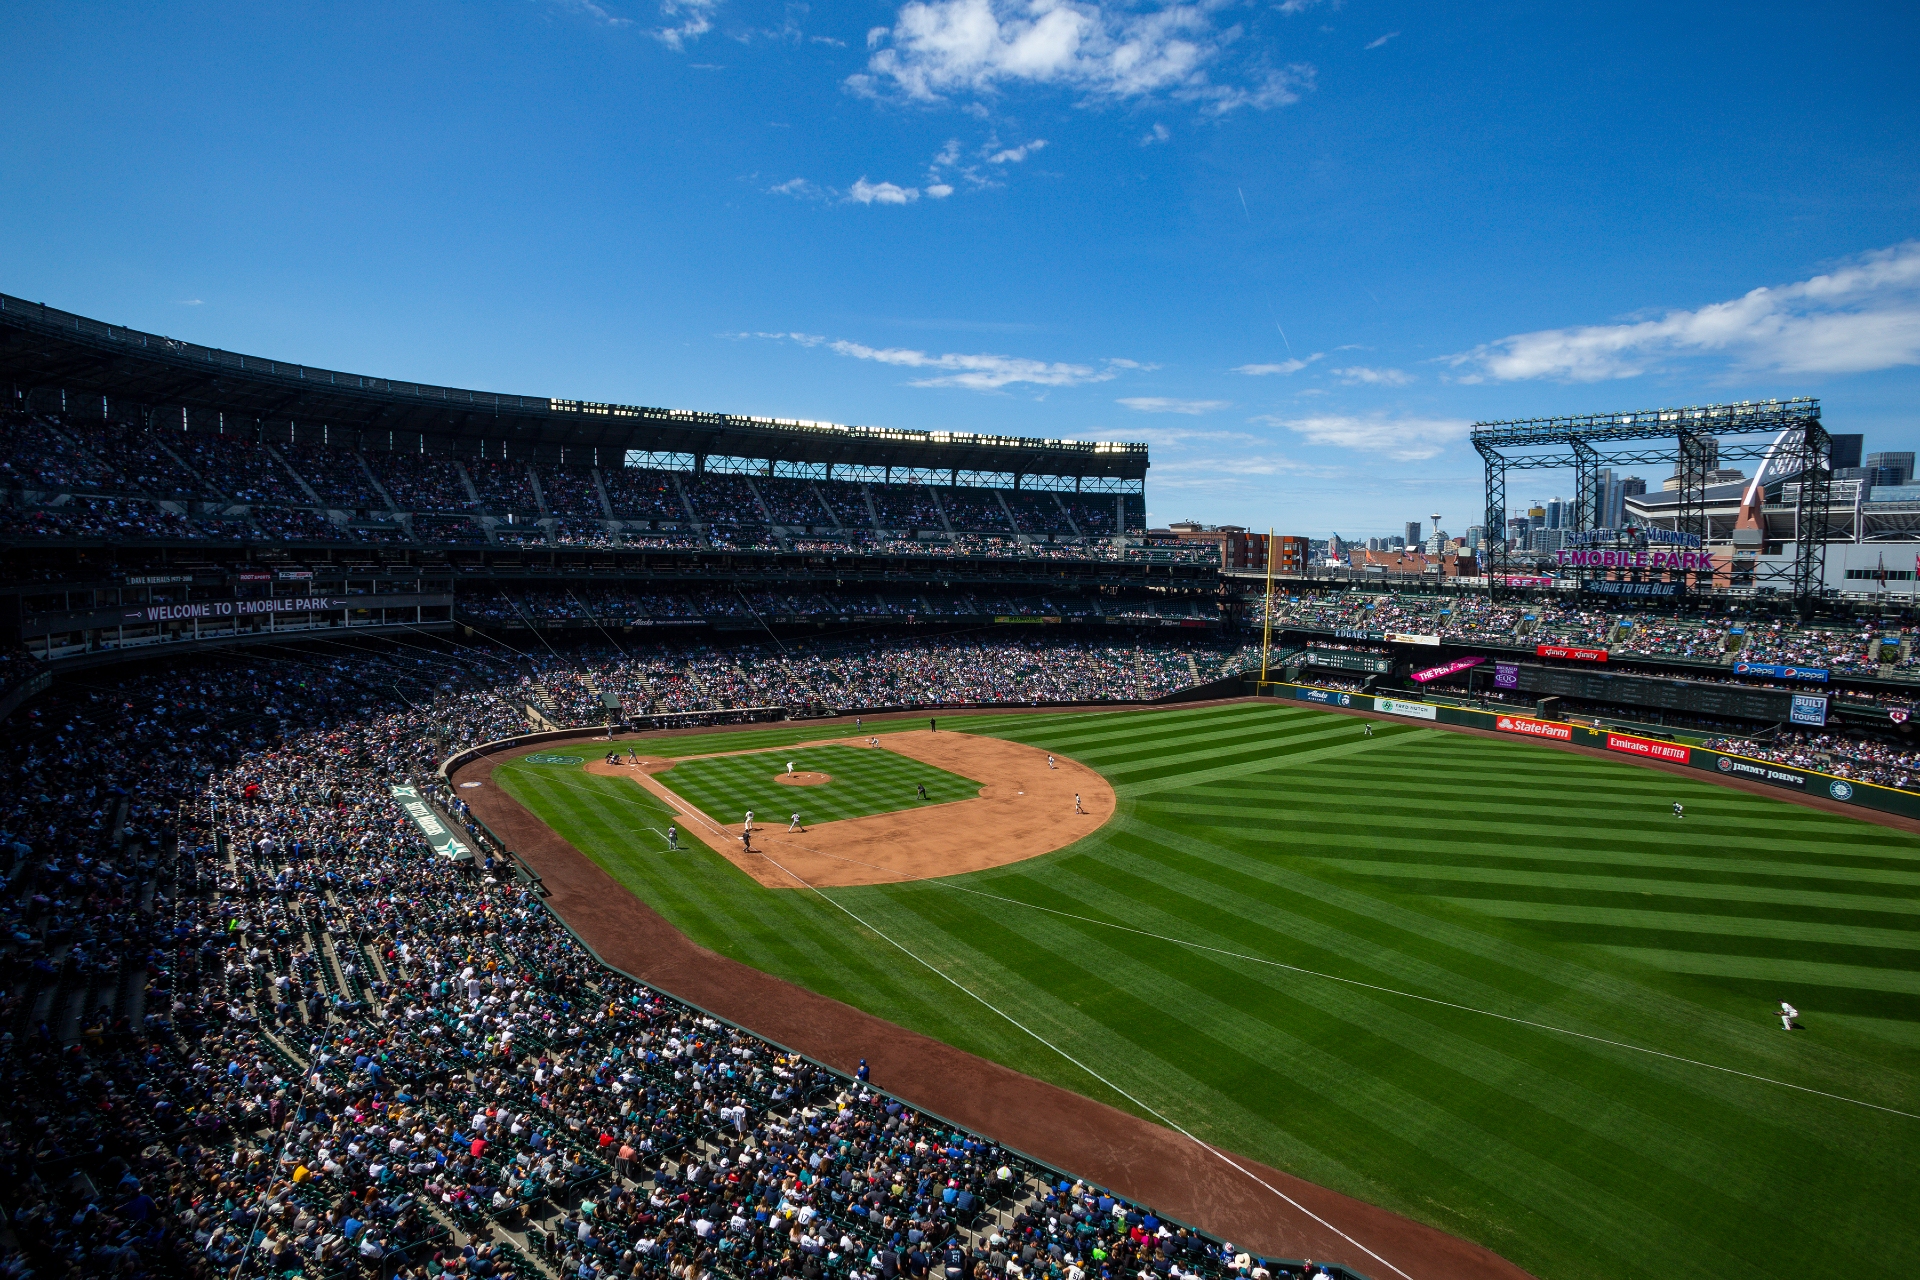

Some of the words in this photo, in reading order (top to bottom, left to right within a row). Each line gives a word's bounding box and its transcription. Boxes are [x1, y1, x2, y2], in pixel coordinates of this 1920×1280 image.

[1568, 528, 1615, 546] SEATTLE
[1645, 527, 1700, 548] MARINERS
[1555, 550, 1648, 567] T-MOBILE
[1653, 551, 1715, 569] PARK
[1621, 583, 1633, 593] TO
[1634, 583, 1651, 594] THE
[147, 603, 210, 620] WELCOME
[214, 602, 231, 615] TO
[237, 599, 293, 613] T-MOBILE
[296, 597, 329, 609] PARK
[630, 618, 654, 626] Alaska
[1545, 649, 1568, 657] xfinity
[1575, 651, 1599, 660] xfinity
[1419, 670, 1434, 681] THE
[1750, 667, 1775, 676] pepsi
[1797, 671, 1825, 680] pepsi
[1307, 690, 1329, 699] Alaska
[1795, 698, 1823, 708] BUILT
[1793, 714, 1821, 722] TOUGH
[1514, 720, 1541, 731] State
[1541, 725, 1569, 738] Farm
[1611, 737, 1649, 752] Emirates
[1651, 745, 1663, 754] FLY
[1663, 747, 1685, 759] BETTER
[1733, 763, 1765, 775] JIMMY
[1767, 770, 1804, 784] JOHN'S
